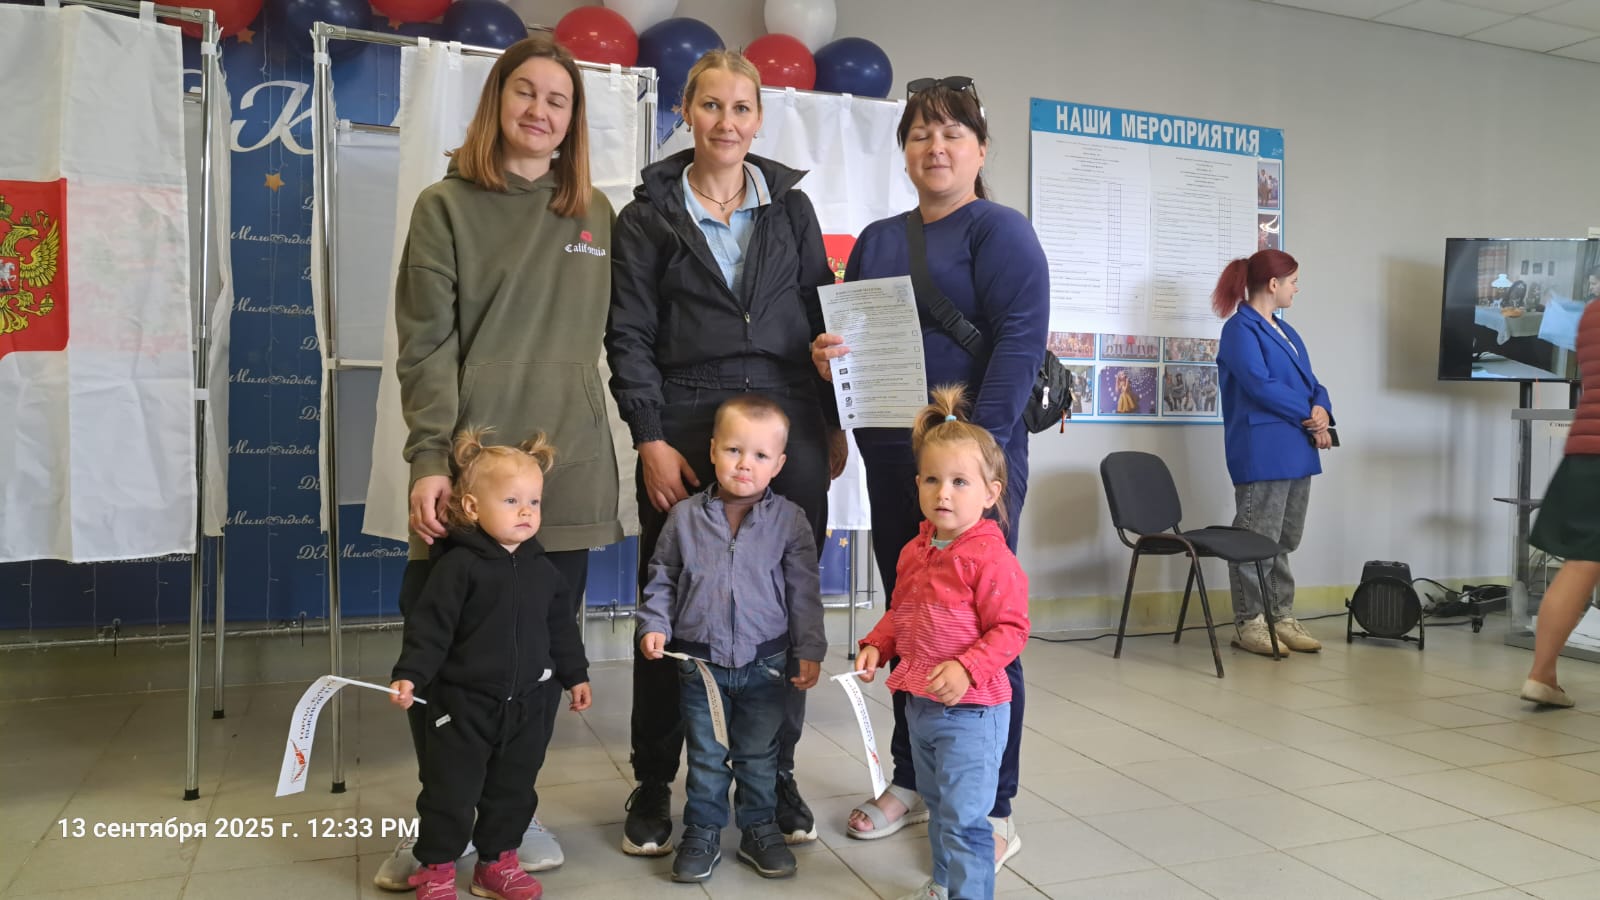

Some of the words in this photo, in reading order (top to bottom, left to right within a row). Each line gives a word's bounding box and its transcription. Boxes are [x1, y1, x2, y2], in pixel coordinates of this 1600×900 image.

[1056, 104, 1111, 136] НАШИ
[1121, 113, 1260, 153] МЕРОПРИЯТИЯ
[564, 242, 606, 257] California
